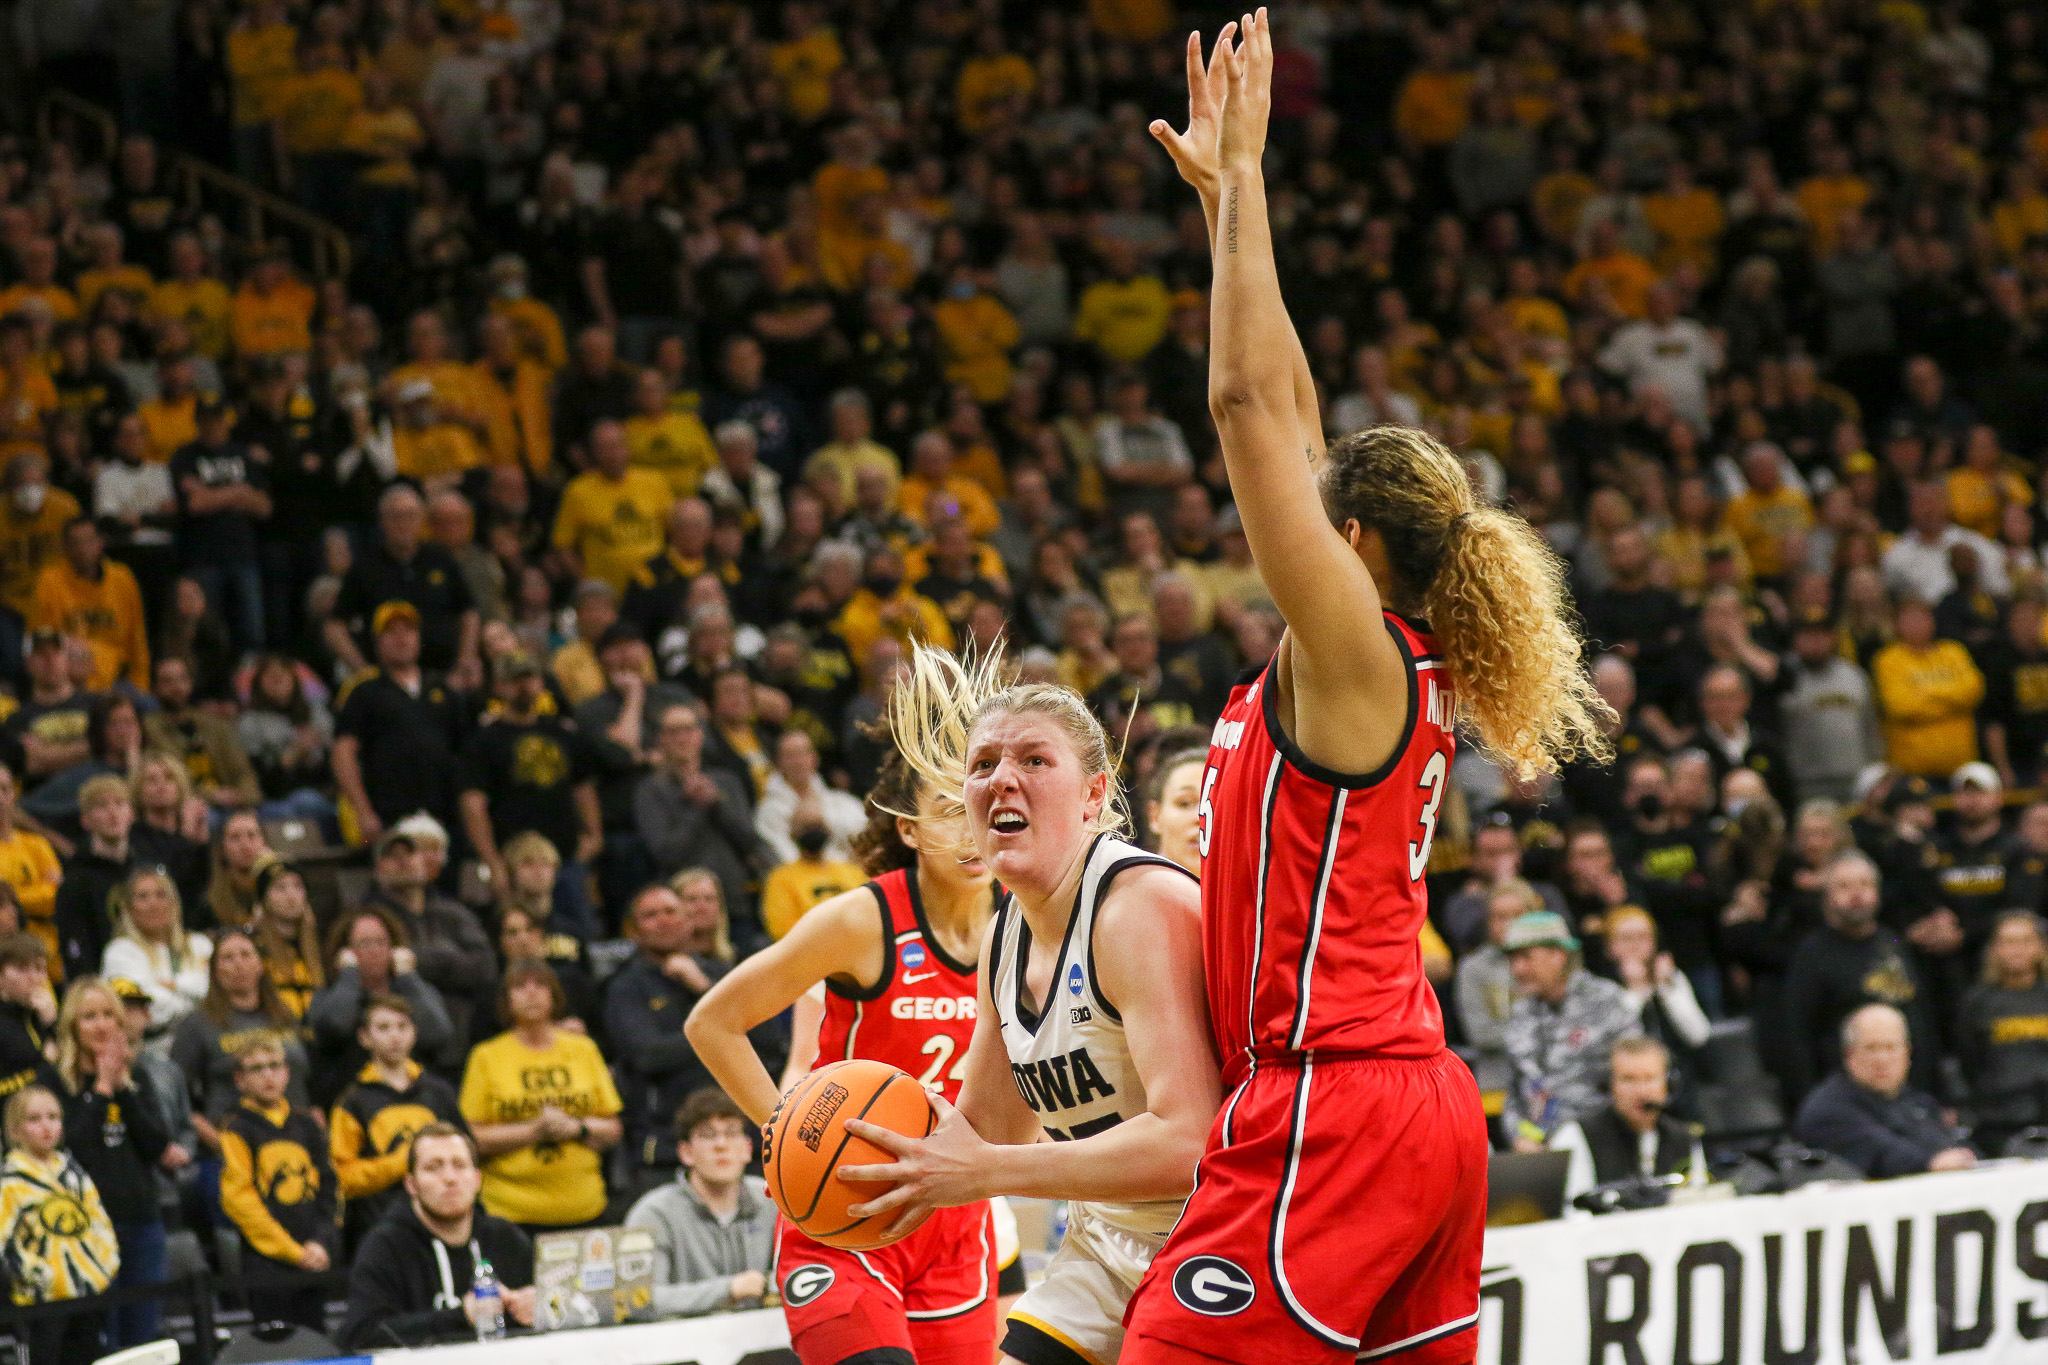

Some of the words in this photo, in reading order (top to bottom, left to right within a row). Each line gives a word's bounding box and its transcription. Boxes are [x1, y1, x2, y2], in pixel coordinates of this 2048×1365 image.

[520, 1065, 572, 1092] GO
[802, 1095, 829, 1131] MARCH
[814, 1085, 848, 1130] MADNESS
[1586, 1200, 2048, 1365] ROUNDS
